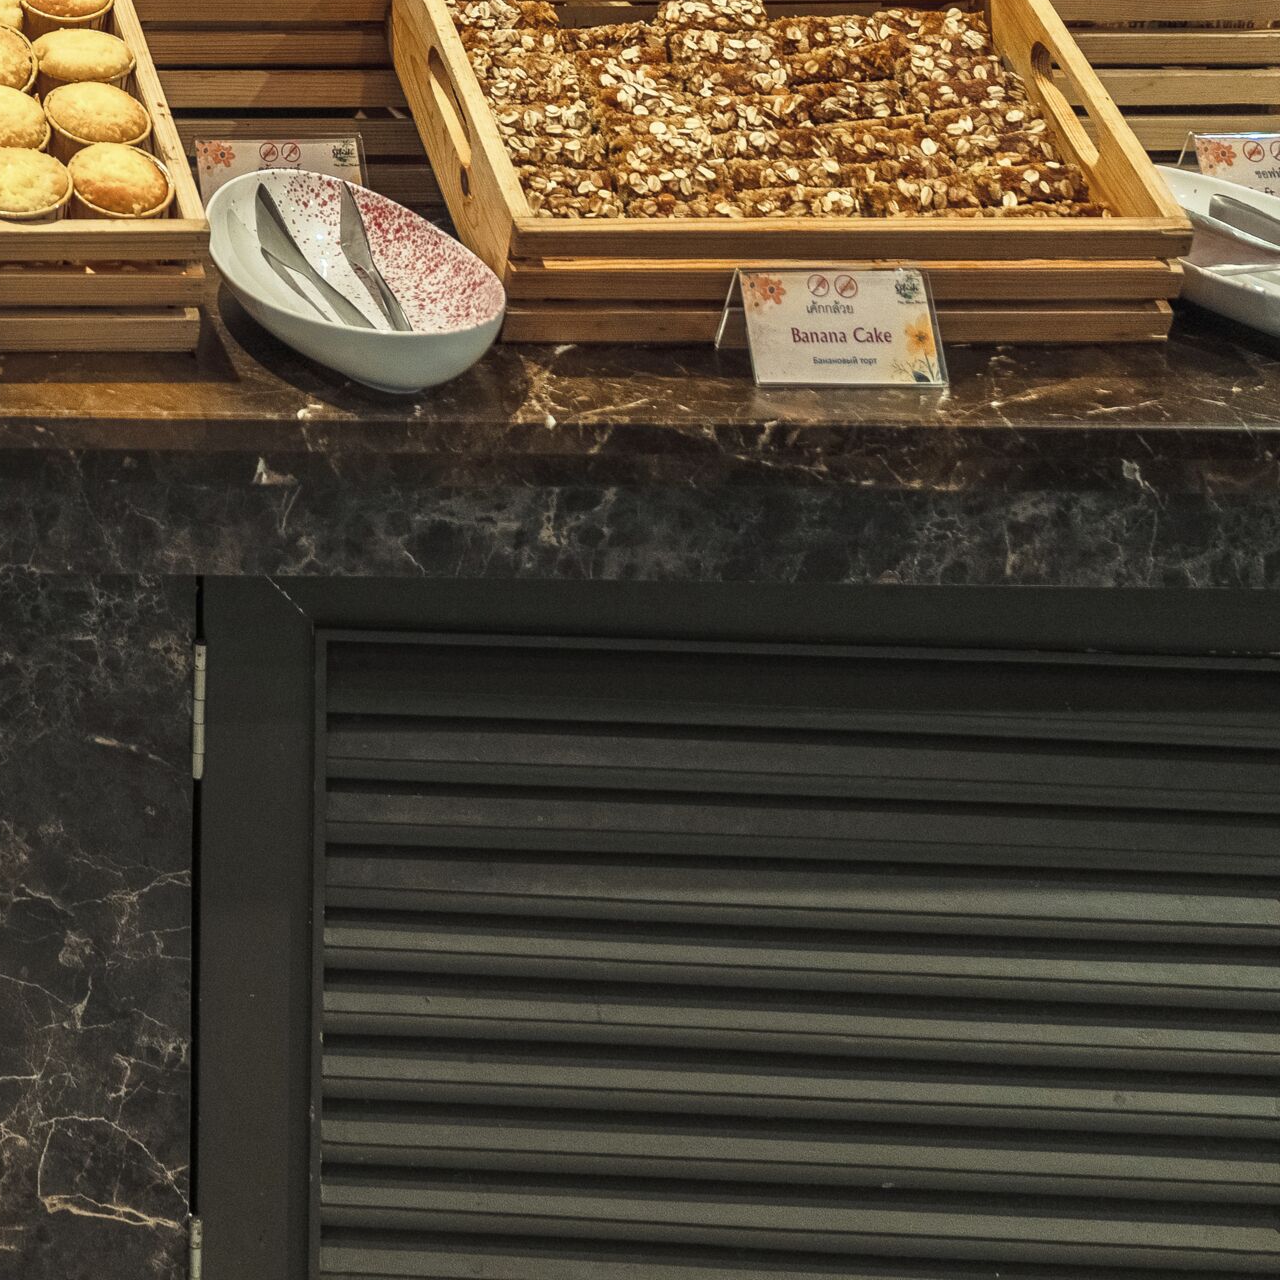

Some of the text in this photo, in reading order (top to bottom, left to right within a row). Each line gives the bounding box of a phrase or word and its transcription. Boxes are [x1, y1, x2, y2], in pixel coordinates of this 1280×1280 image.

[791, 327, 892, 344] Banana Cake
[860, 357, 878, 367] торт
